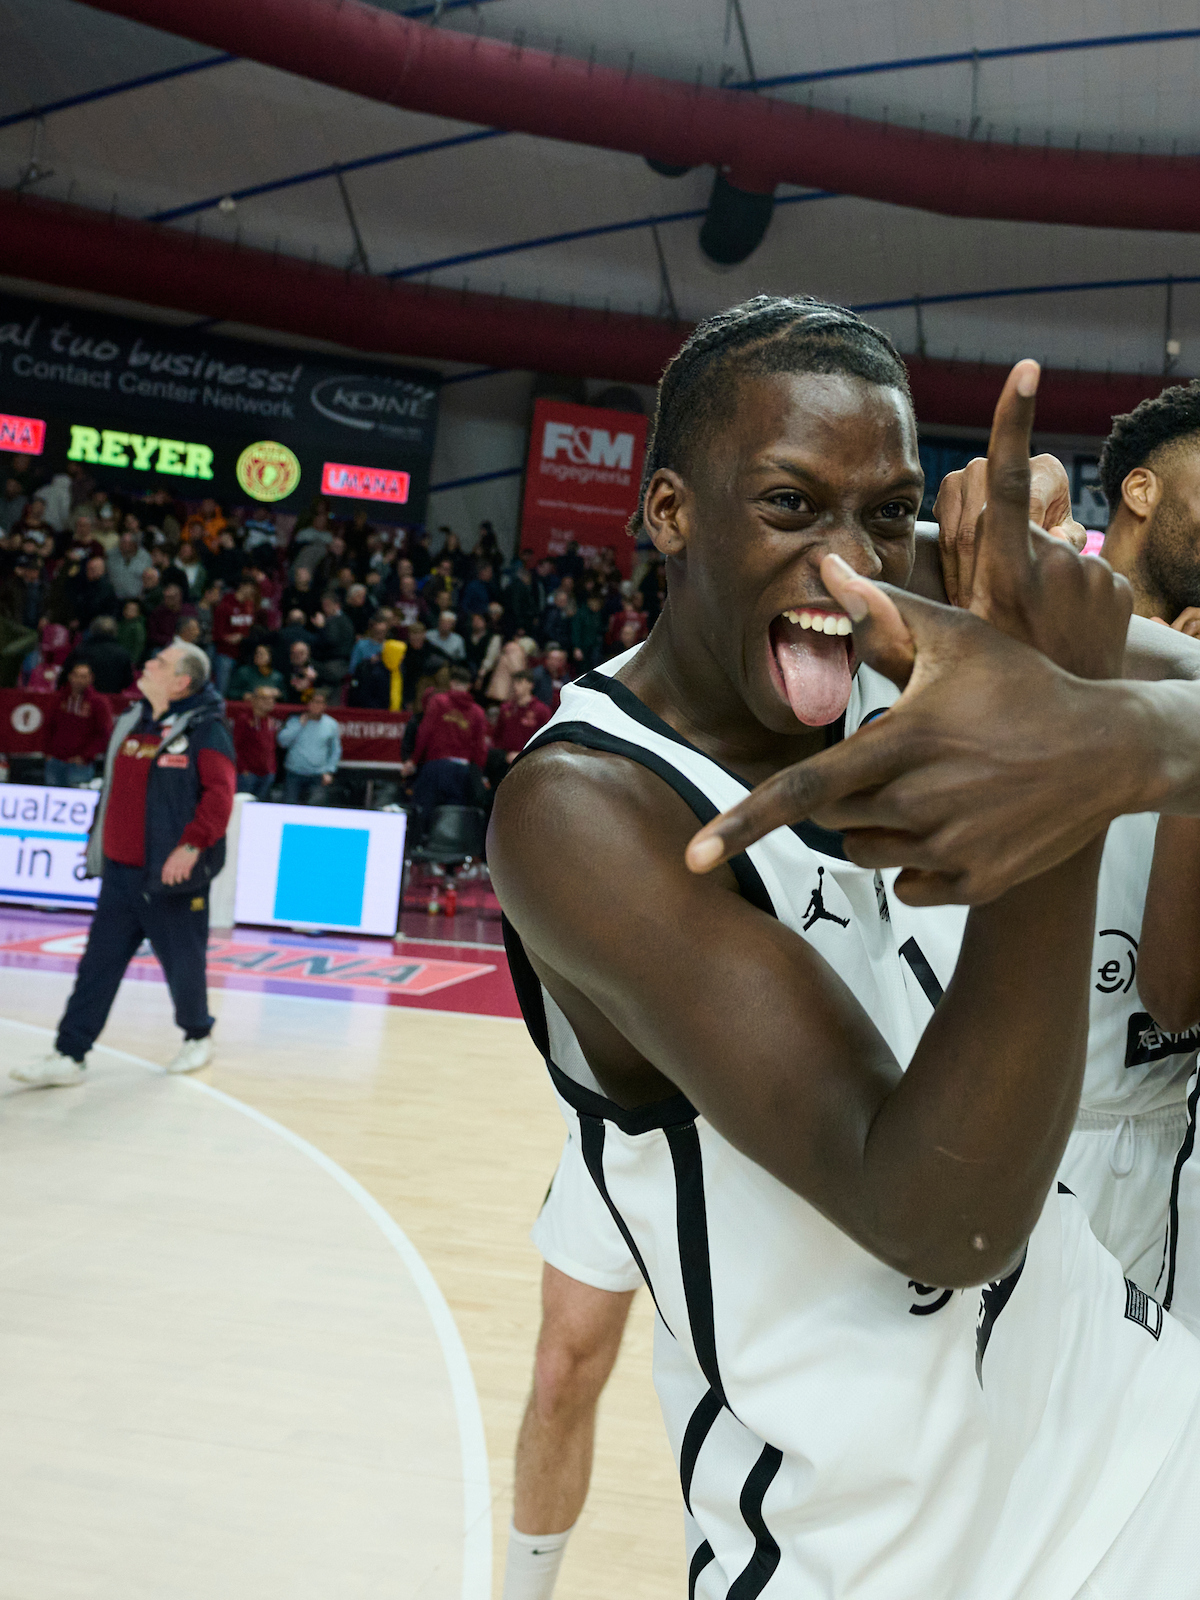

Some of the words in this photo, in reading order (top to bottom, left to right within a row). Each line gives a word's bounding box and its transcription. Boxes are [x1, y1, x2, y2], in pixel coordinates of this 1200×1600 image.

[51, 321, 119, 361] tuo
[127, 338, 303, 394] business!
[12, 353, 112, 390] Contact
[118, 371, 199, 403] Center
[203, 384, 295, 419] Network
[67, 424, 214, 480] REYER
[541, 421, 635, 471] F&M
[328, 469, 400, 496] UMANA
[15, 836, 52, 878] in
